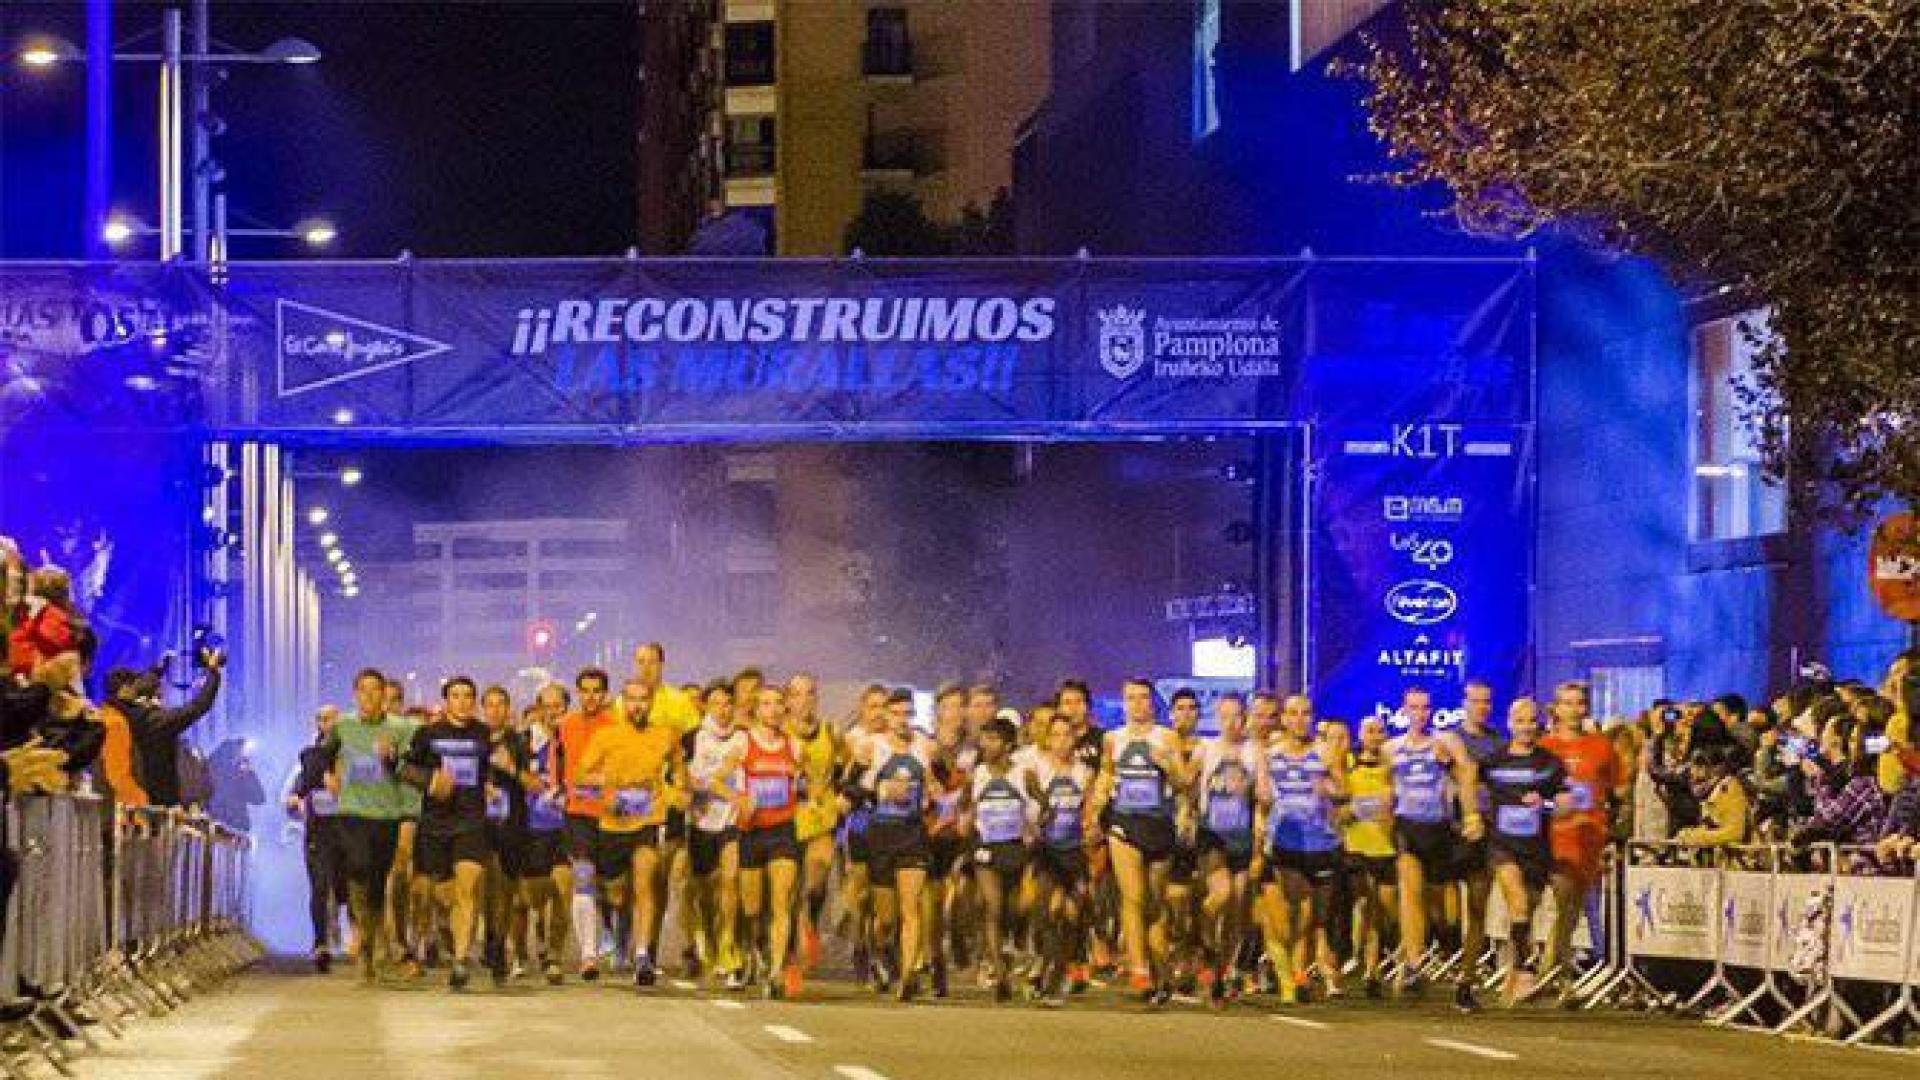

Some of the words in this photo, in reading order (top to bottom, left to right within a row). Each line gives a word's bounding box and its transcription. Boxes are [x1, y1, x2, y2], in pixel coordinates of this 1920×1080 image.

[1260, 314, 1279, 330] de
[1154, 331, 1279, 361] Pamplona
[1392, 423, 1463, 458] K1T
[1378, 650, 1465, 665] ALTAFIT
